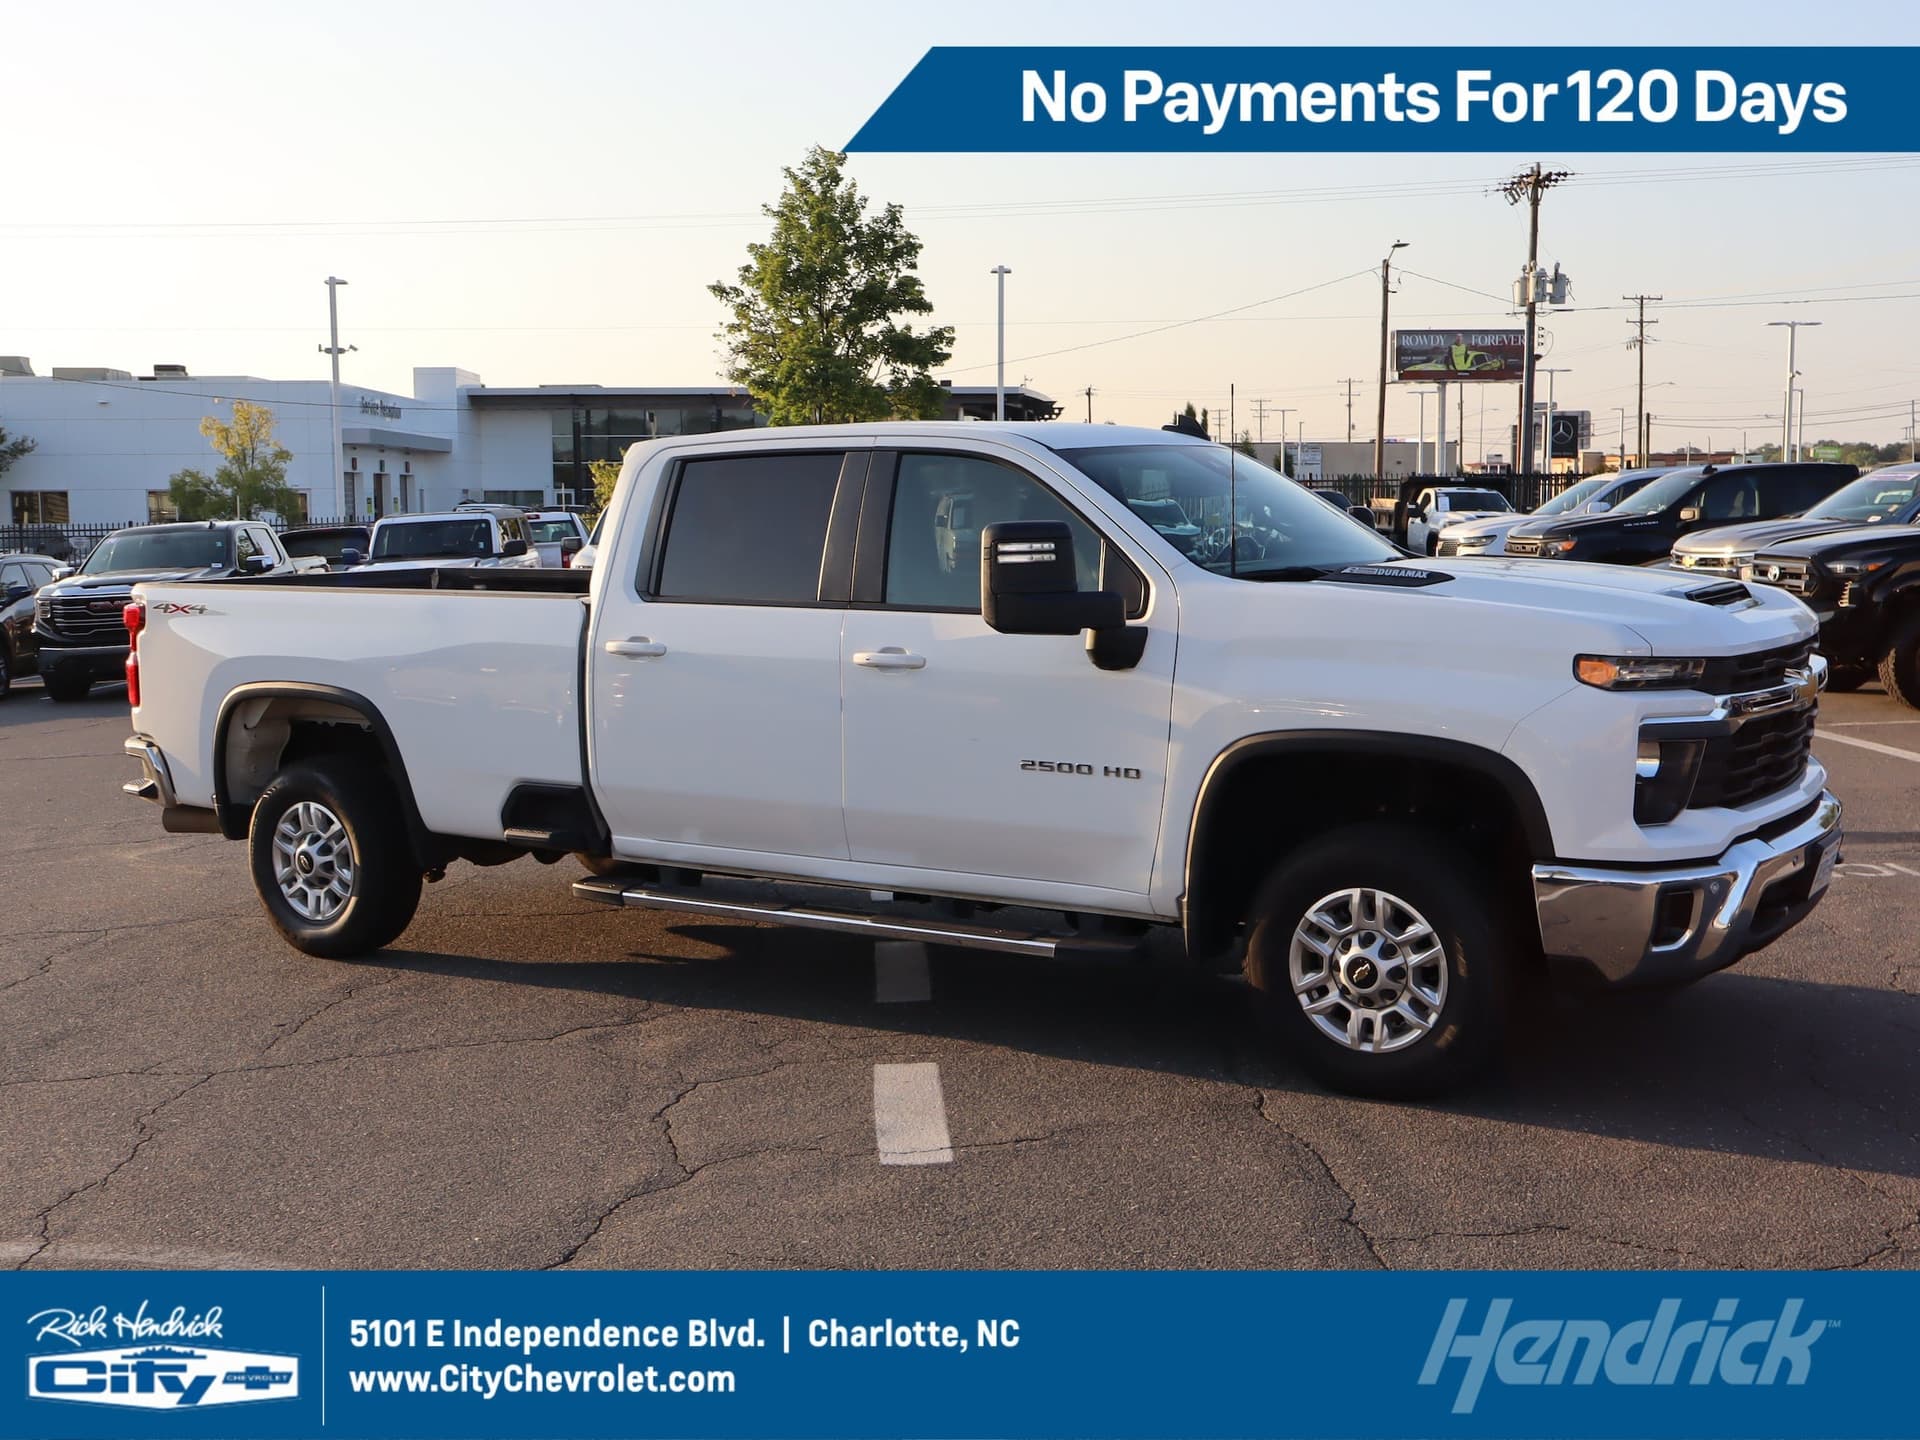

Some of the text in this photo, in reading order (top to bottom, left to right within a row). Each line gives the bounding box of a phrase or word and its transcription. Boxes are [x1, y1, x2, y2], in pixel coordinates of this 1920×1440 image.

[1401, 334, 1447, 346] ROWDY
[1376, 568, 1429, 579] DURAMAX
[1020, 759, 1141, 780] 2500 HD
